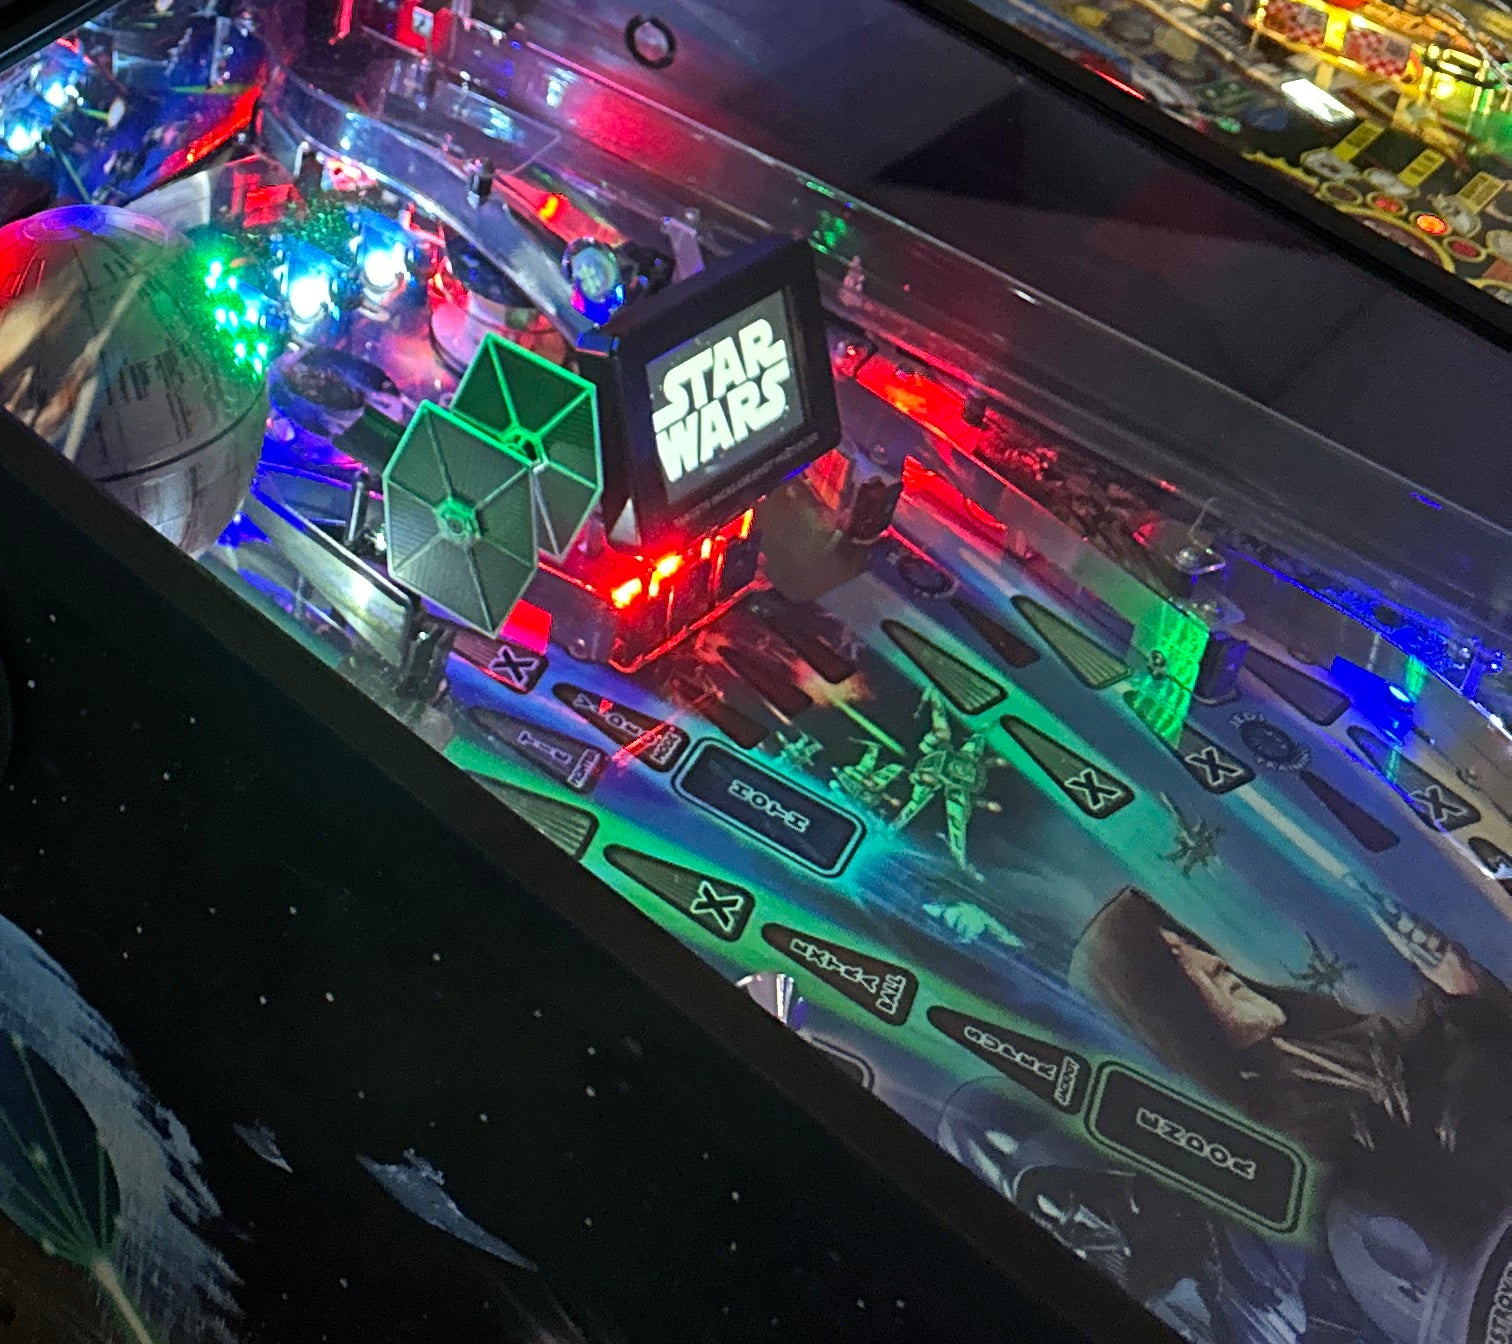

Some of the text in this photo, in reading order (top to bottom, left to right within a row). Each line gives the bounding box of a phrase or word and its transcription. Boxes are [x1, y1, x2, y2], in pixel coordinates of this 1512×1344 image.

[652, 318, 788, 433] STAR
[655, 359, 791, 483] WARS
[518, 728, 573, 765] TIE
[727, 778, 811, 834] HOTH
[789, 937, 881, 994] EXTRA
[875, 973, 907, 1015] BALL
[963, 1024, 1058, 1081] SUPER
[1135, 1106, 1258, 1181] ENDOR
